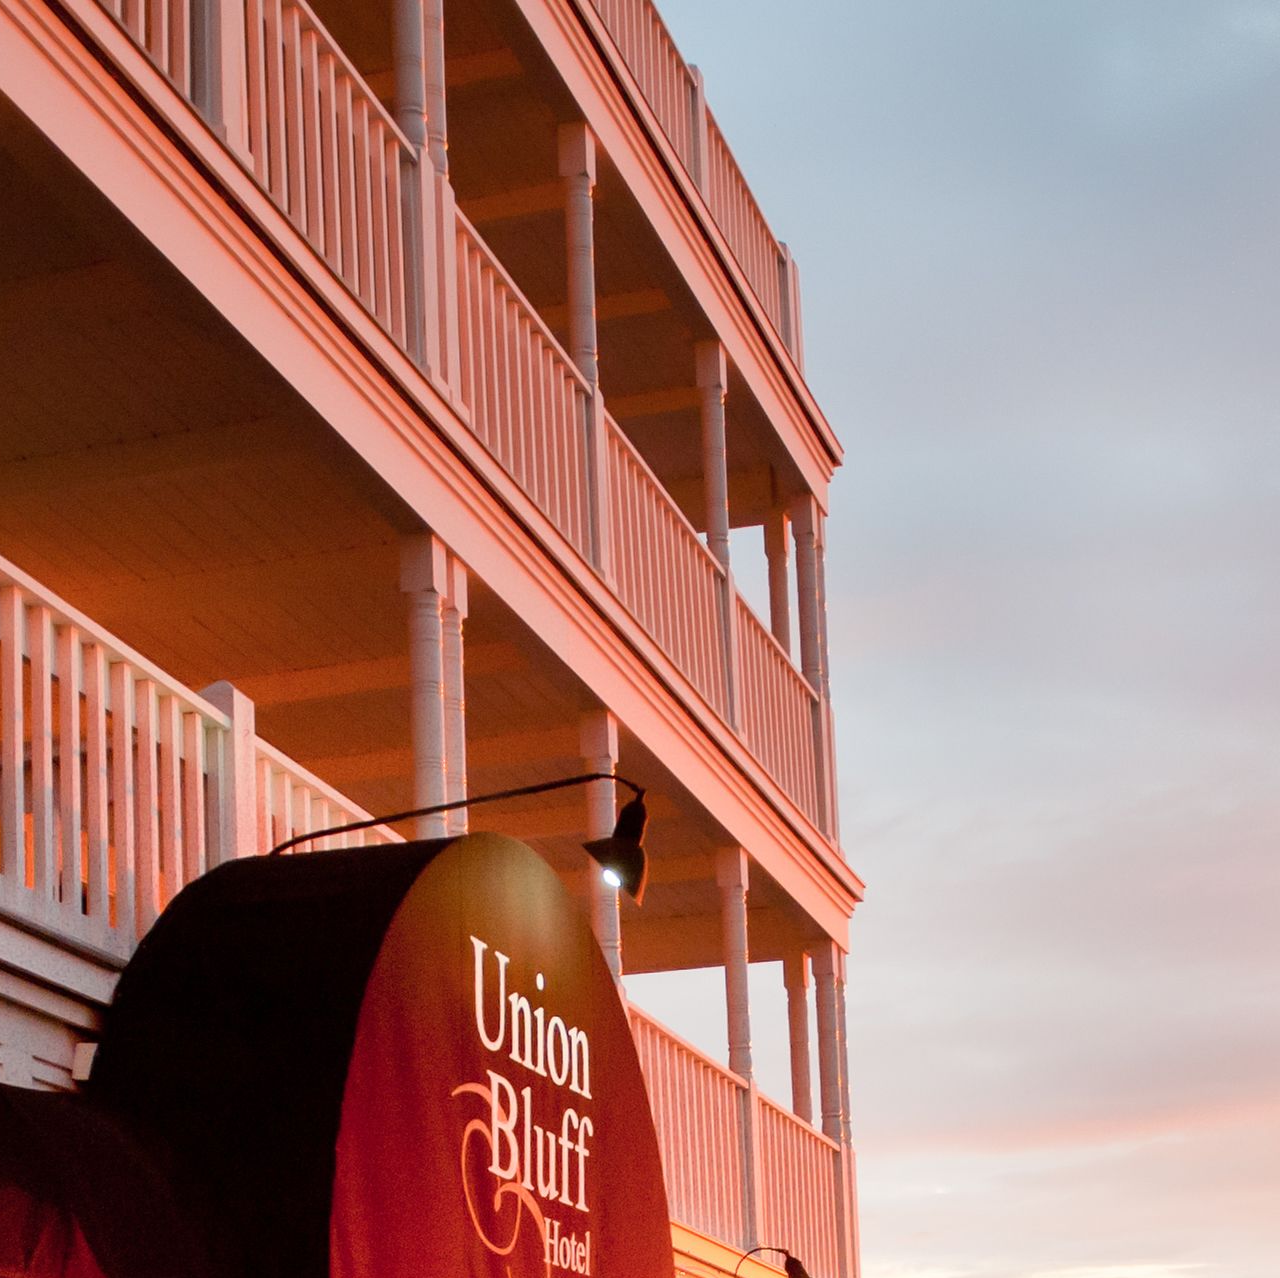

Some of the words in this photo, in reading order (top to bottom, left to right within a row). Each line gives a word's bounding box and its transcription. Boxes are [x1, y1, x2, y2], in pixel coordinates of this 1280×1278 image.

[470, 935, 592, 1100] Union
[486, 1069, 594, 1213] Bluff
[543, 1217, 591, 1276] Hotel
